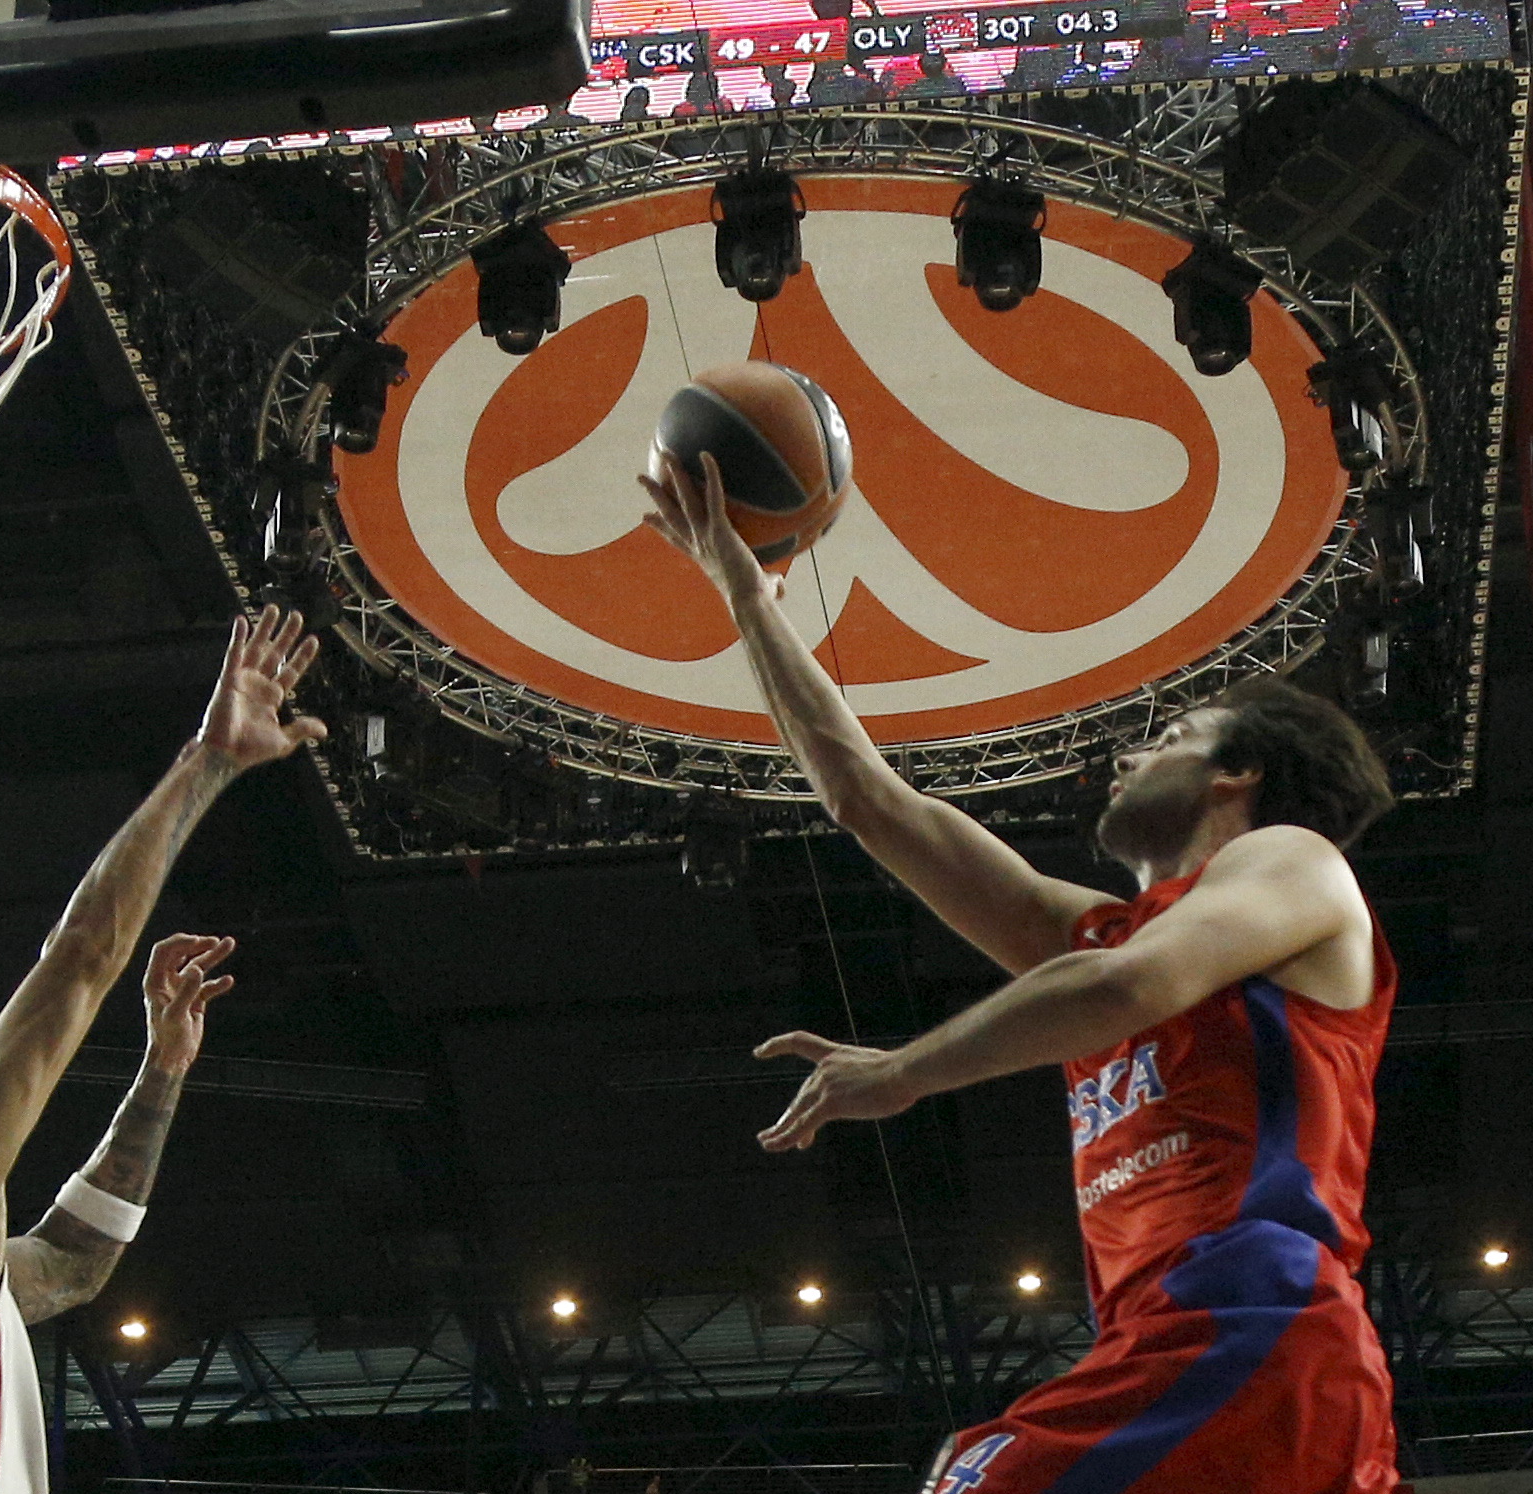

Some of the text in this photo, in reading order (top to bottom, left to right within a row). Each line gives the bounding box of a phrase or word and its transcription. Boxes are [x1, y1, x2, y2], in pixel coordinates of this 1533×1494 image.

[638, 43, 695, 68] CSK
[718, 39, 755, 60] 49
[795, 31, 831, 53] 47
[853, 25, 912, 49] OLY
[984, 15, 1036, 42] 3QT
[1056, 10, 1118, 35] 04.3
